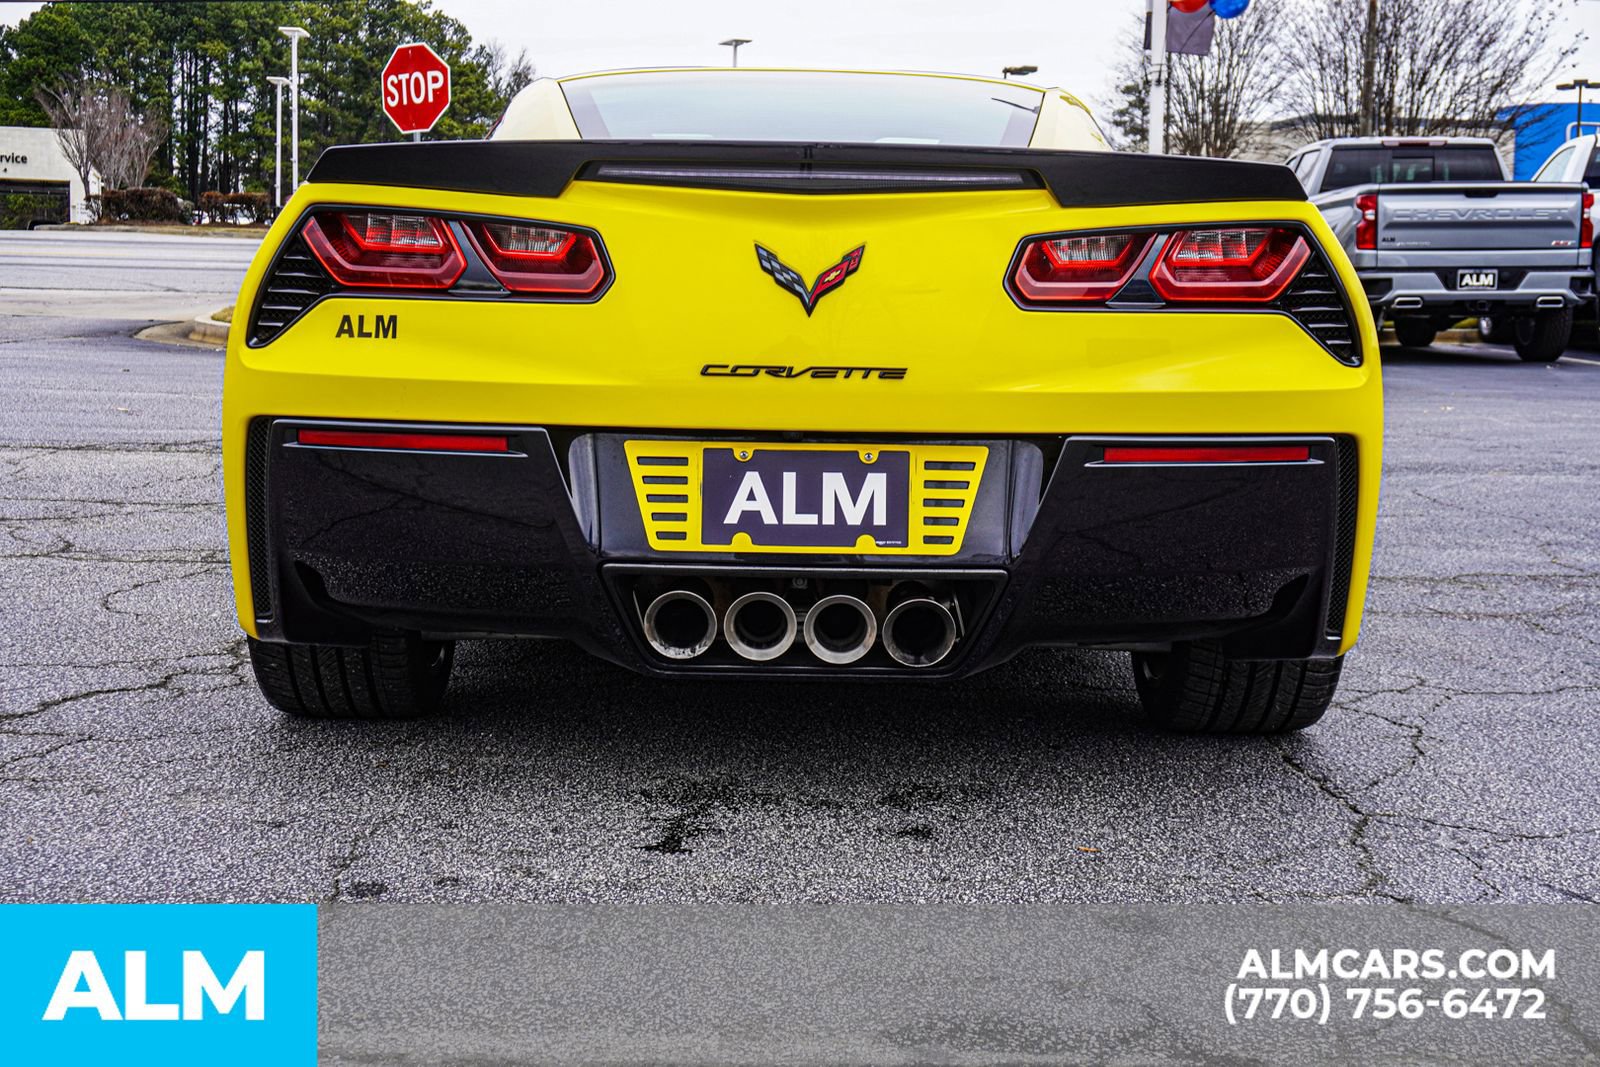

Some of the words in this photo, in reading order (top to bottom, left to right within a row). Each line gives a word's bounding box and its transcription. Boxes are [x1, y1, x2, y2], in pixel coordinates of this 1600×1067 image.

[387, 70, 444, 108] STOP
[1392, 207, 1568, 222] CHEVROLET
[1461, 273, 1494, 286] ALM
[335, 314, 398, 339] ALM
[700, 364, 908, 380] CORVETTE
[723, 470, 887, 526] ALM
